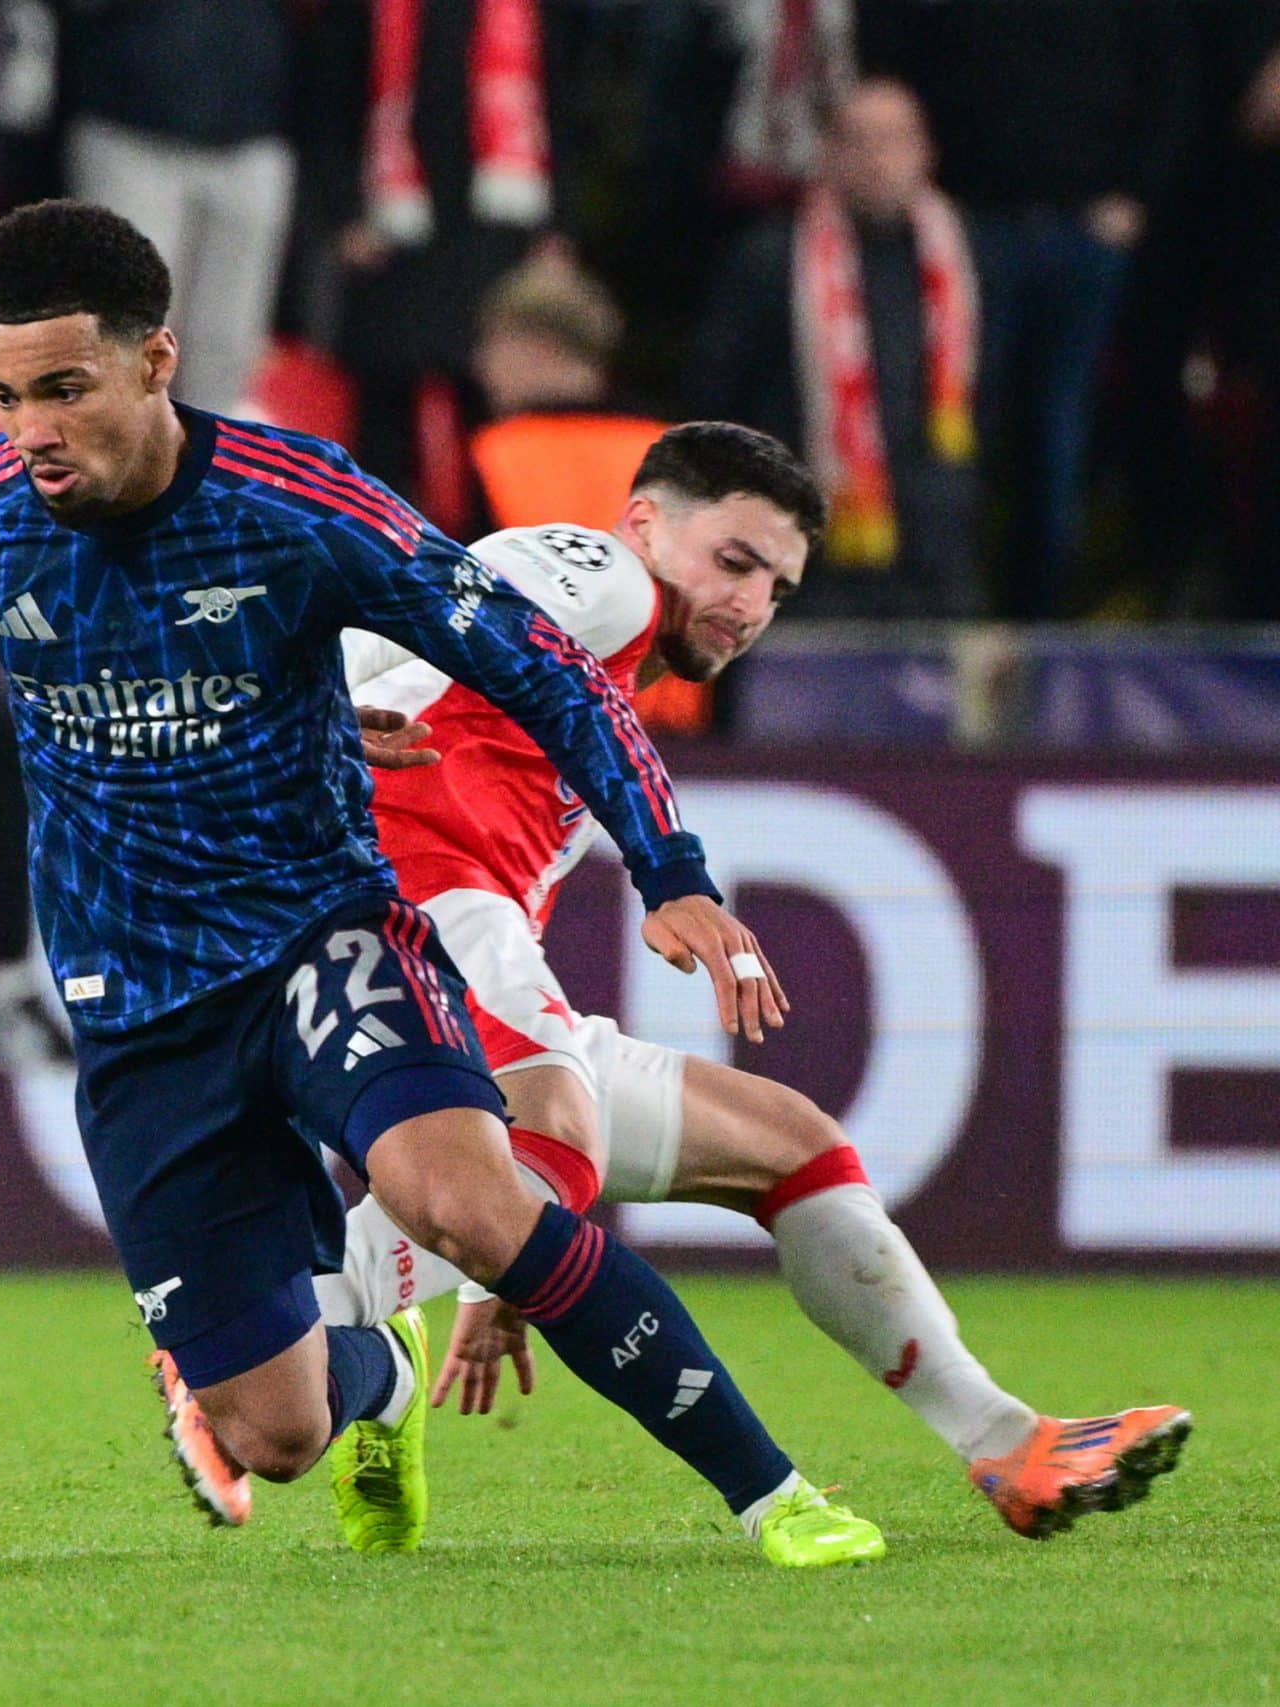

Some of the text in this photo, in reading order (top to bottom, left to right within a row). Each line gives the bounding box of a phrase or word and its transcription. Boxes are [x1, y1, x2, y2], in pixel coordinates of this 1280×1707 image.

[10, 668, 263, 719] Emirates
[51, 712, 96, 753] FLY
[285, 928, 405, 1062] 22
[610, 1311, 659, 1370] AFC
